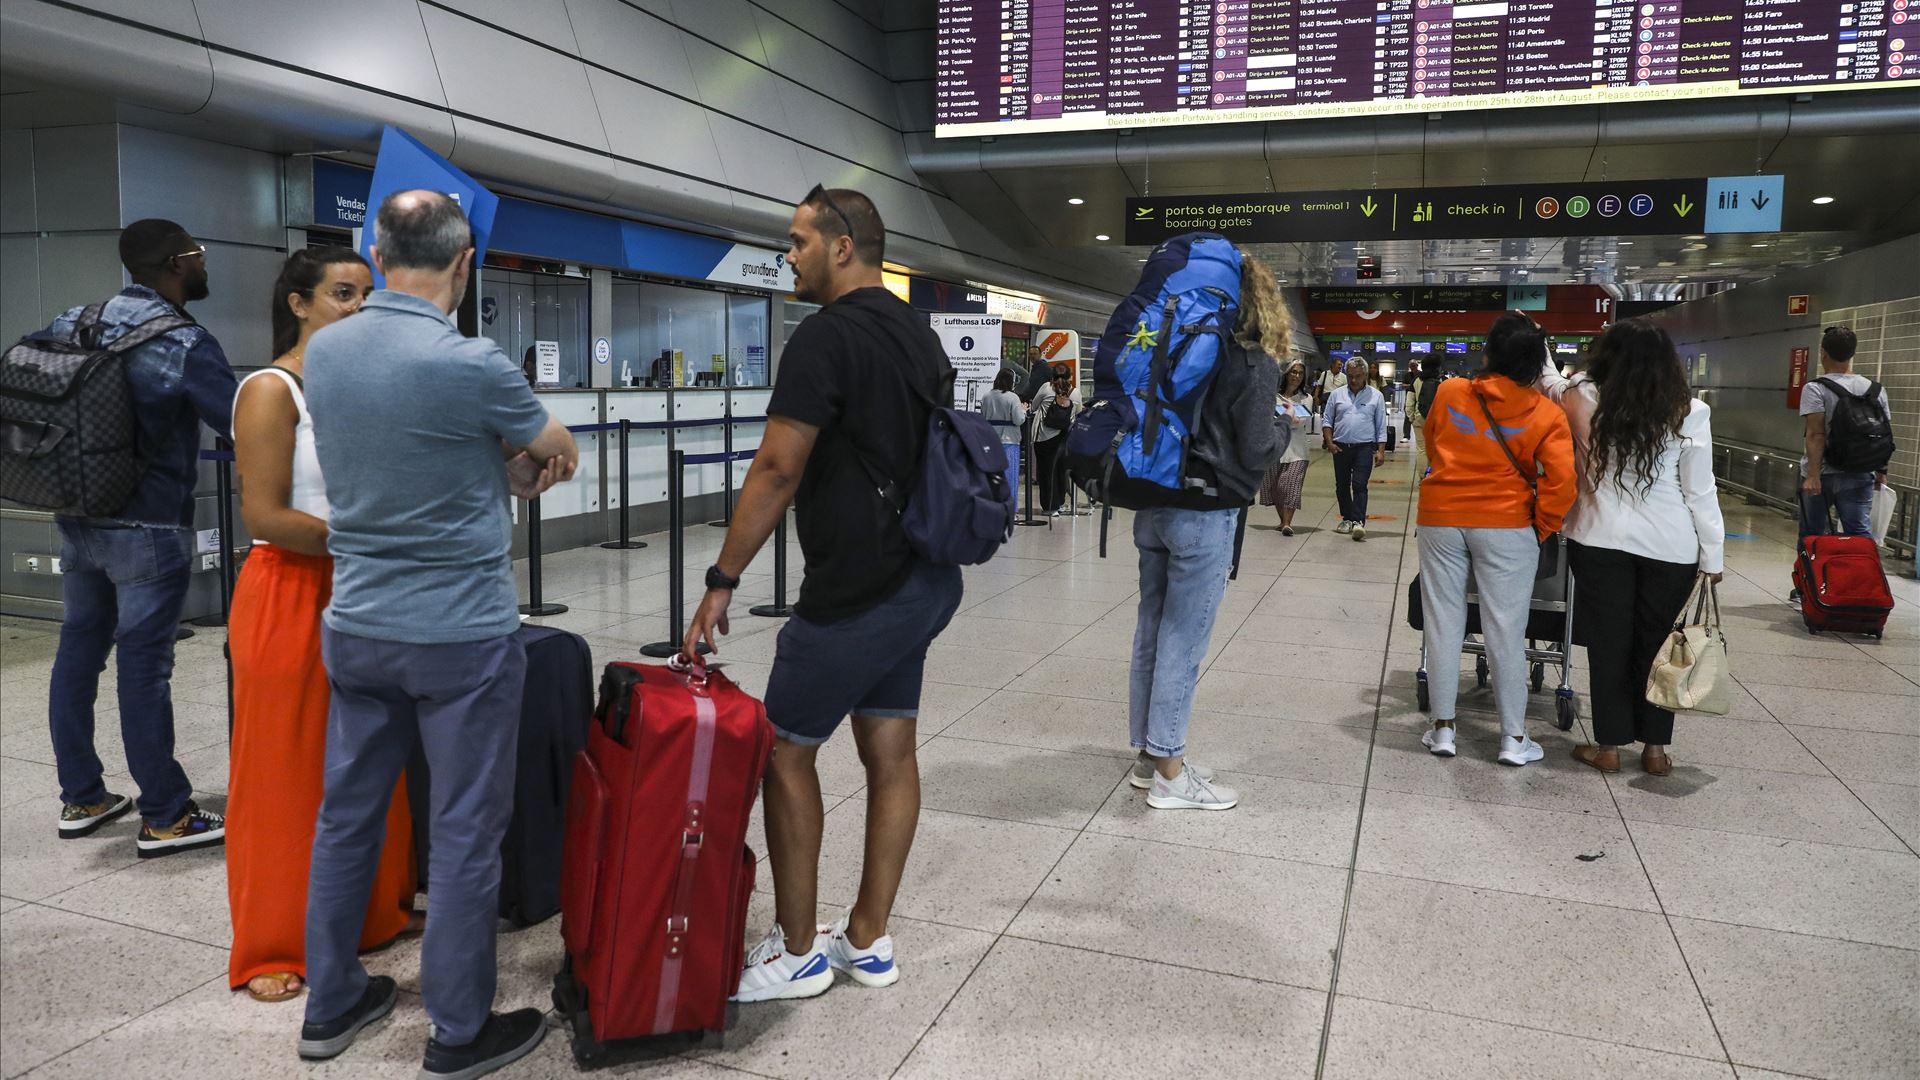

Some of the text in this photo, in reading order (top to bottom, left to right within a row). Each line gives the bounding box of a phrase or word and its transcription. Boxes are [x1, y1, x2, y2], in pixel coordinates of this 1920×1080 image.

[1345, 17, 1371, 25] Charleroi
[1392, 13, 1413, 21] FR1301
[1764, 22, 1803, 31] Marrakech
[1527, 39, 1565, 47] Amesterdão
[1764, 36, 1795, 44] Londres,
[1796, 34, 1828, 42] Stansted
[1539, 64, 1558, 72] Paulo,
[1559, 62, 1591, 70] Guarulhos
[1762, 62, 1803, 70] Casablanca
[1525, 77, 1546, 85] Berlin,
[1548, 74, 1590, 84] Brandenburg
[1761, 75, 1792, 83] Londres,
[1108, 118, 1122, 126] Due
[1182, 113, 1221, 123] Portway's
[1223, 111, 1258, 121] handling
[1259, 110, 1296, 119] services,
[1298, 107, 1345, 116] constraints
[1348, 107, 1365, 115] may
[1405, 102, 1419, 110] the
[1421, 100, 1462, 112] operation
[1466, 99, 1488, 107] from
[1490, 97, 1510, 105] 25th
[1525, 96, 1544, 104] 28th
[1559, 93, 1593, 103] August.
[1600, 91, 1630, 100] Please
[1634, 89, 1669, 98] contact
[1672, 87, 1694, 97] your
[1698, 86, 1731, 94] airline.
[336, 196, 365, 210] Vendas
[1448, 199, 1646, 216] check in C D E F
[1165, 202, 1349, 218] portas de embarque terminal 1
[1165, 216, 1252, 229] boarding gates
[742, 263, 778, 277] groundforce
[621, 360, 632, 387] 4
[687, 361, 694, 386] 5
[735, 363, 743, 385] 6
